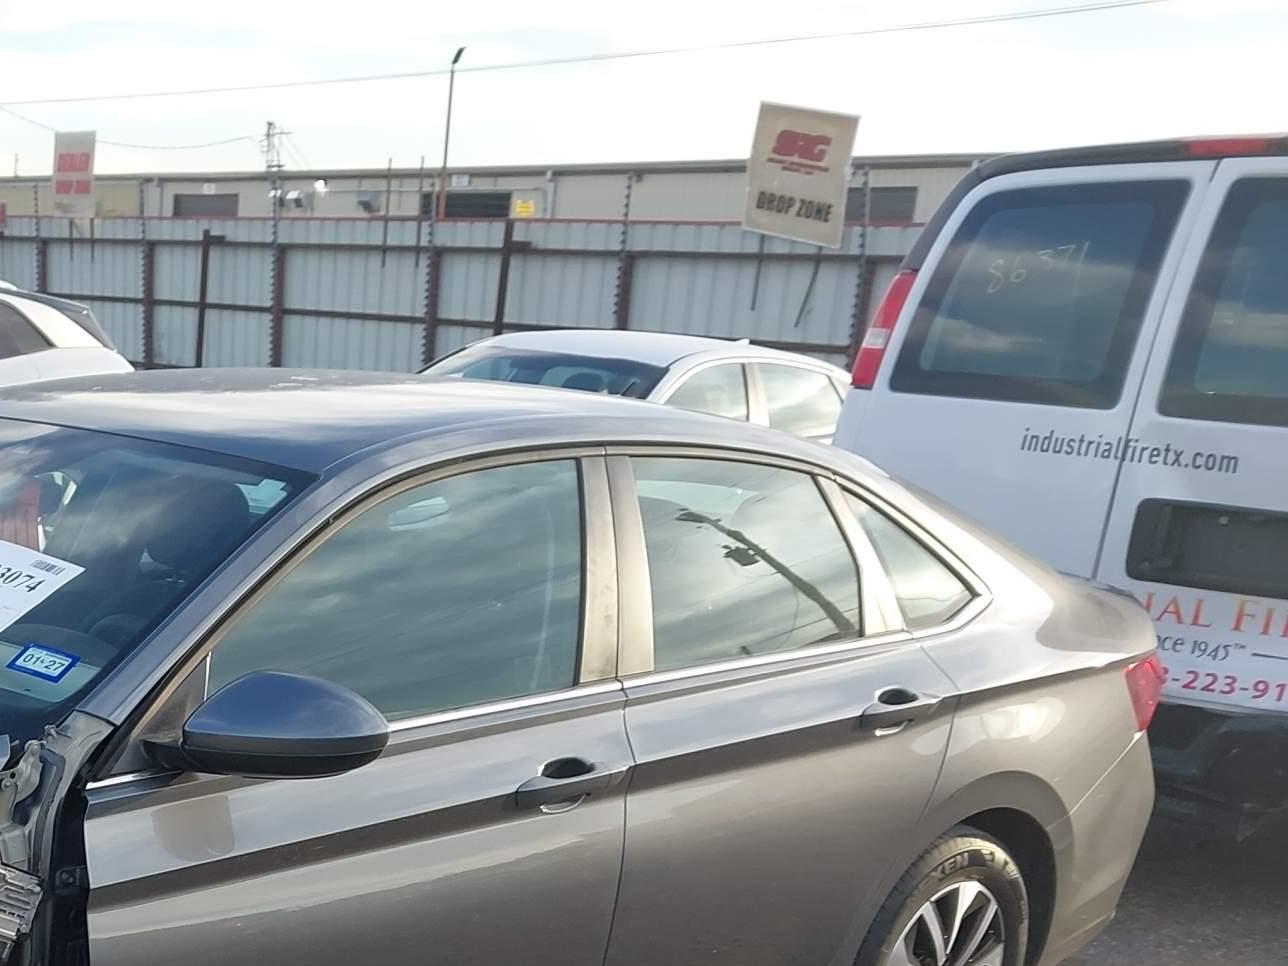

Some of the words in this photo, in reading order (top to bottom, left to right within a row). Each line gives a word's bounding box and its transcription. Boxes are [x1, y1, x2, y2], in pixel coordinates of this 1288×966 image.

[756, 191, 796, 213] DROP
[796, 198, 833, 223] ZONE
[1020, 428, 1239, 474] industrialfiretx.com
